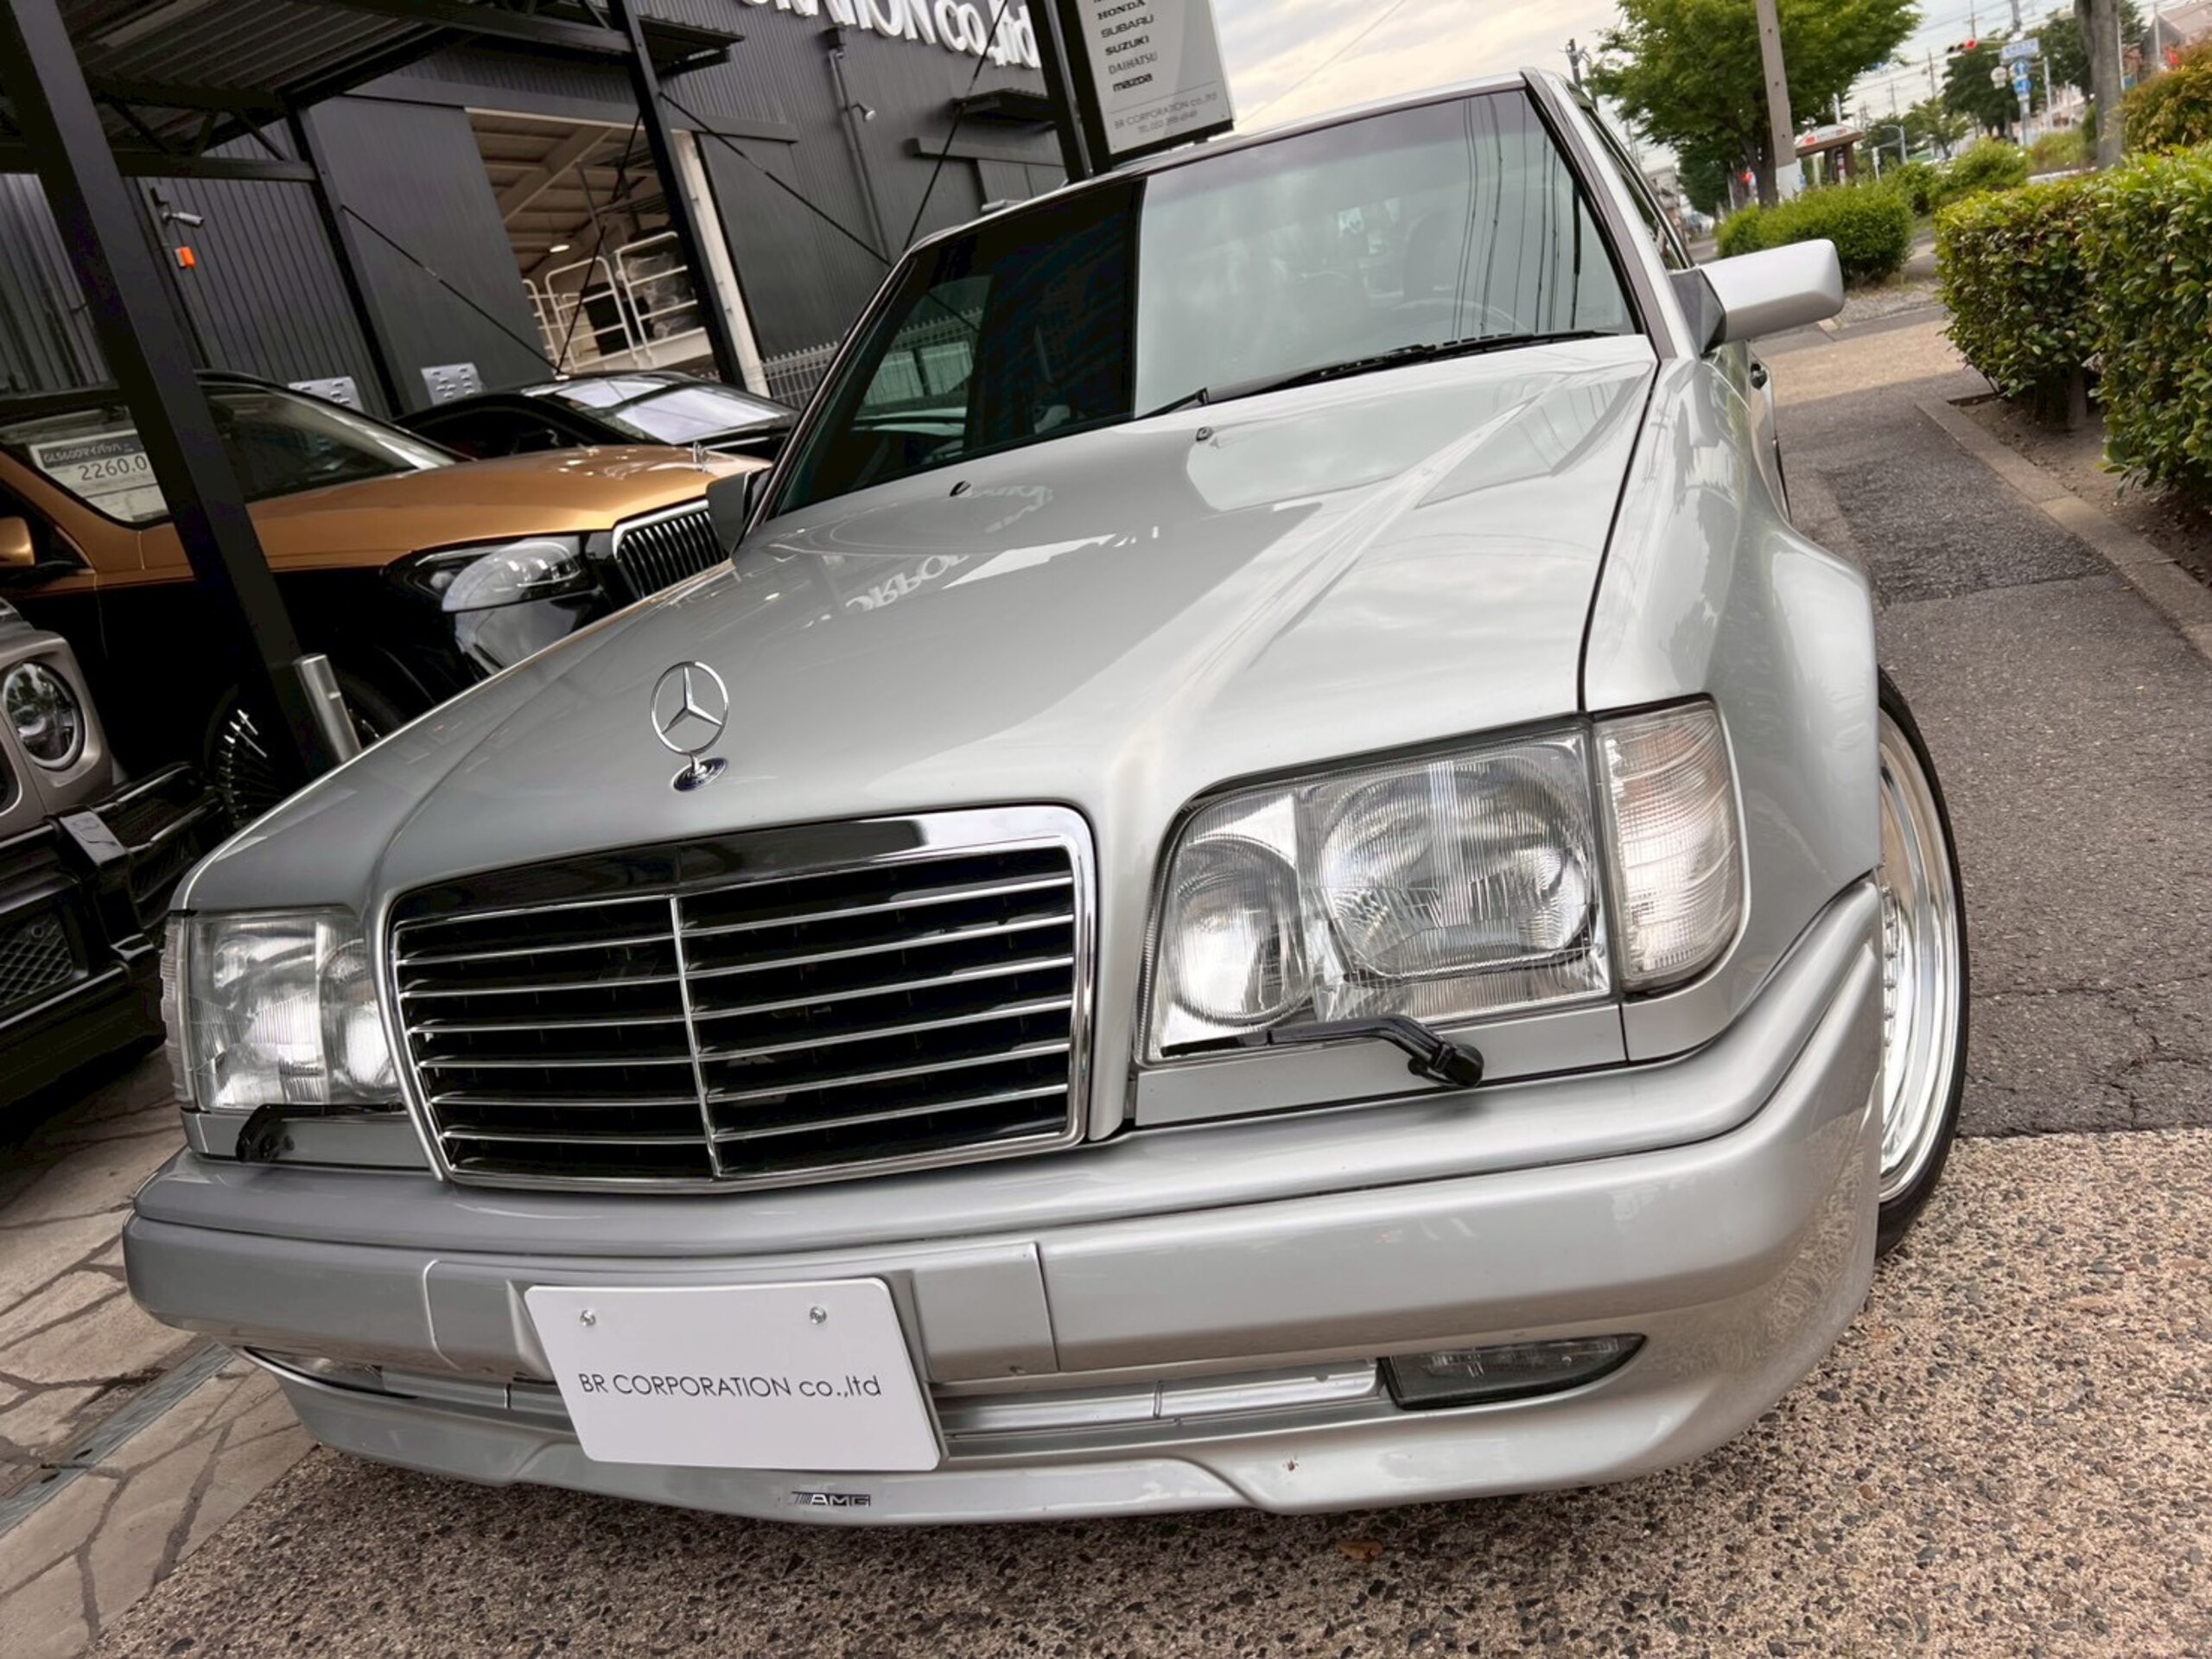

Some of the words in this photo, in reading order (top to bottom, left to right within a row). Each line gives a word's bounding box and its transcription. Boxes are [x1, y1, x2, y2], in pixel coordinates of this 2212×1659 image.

[1096, 0, 1146, 21] HONDA
[1101, 14, 1154, 38] SUBARU
[1105, 35, 1150, 56] SUZUKI
[1108, 51, 1158, 75] DAIHATSU
[1112, 73, 1154, 92] mazda
[78, 454, 149, 481] 2260.0
[578, 1373, 608, 1394] BR
[613, 1374, 792, 1398] CORPORATION
[798, 1376, 882, 1399] co.,ltd
[810, 1493, 871, 1507] AMG
